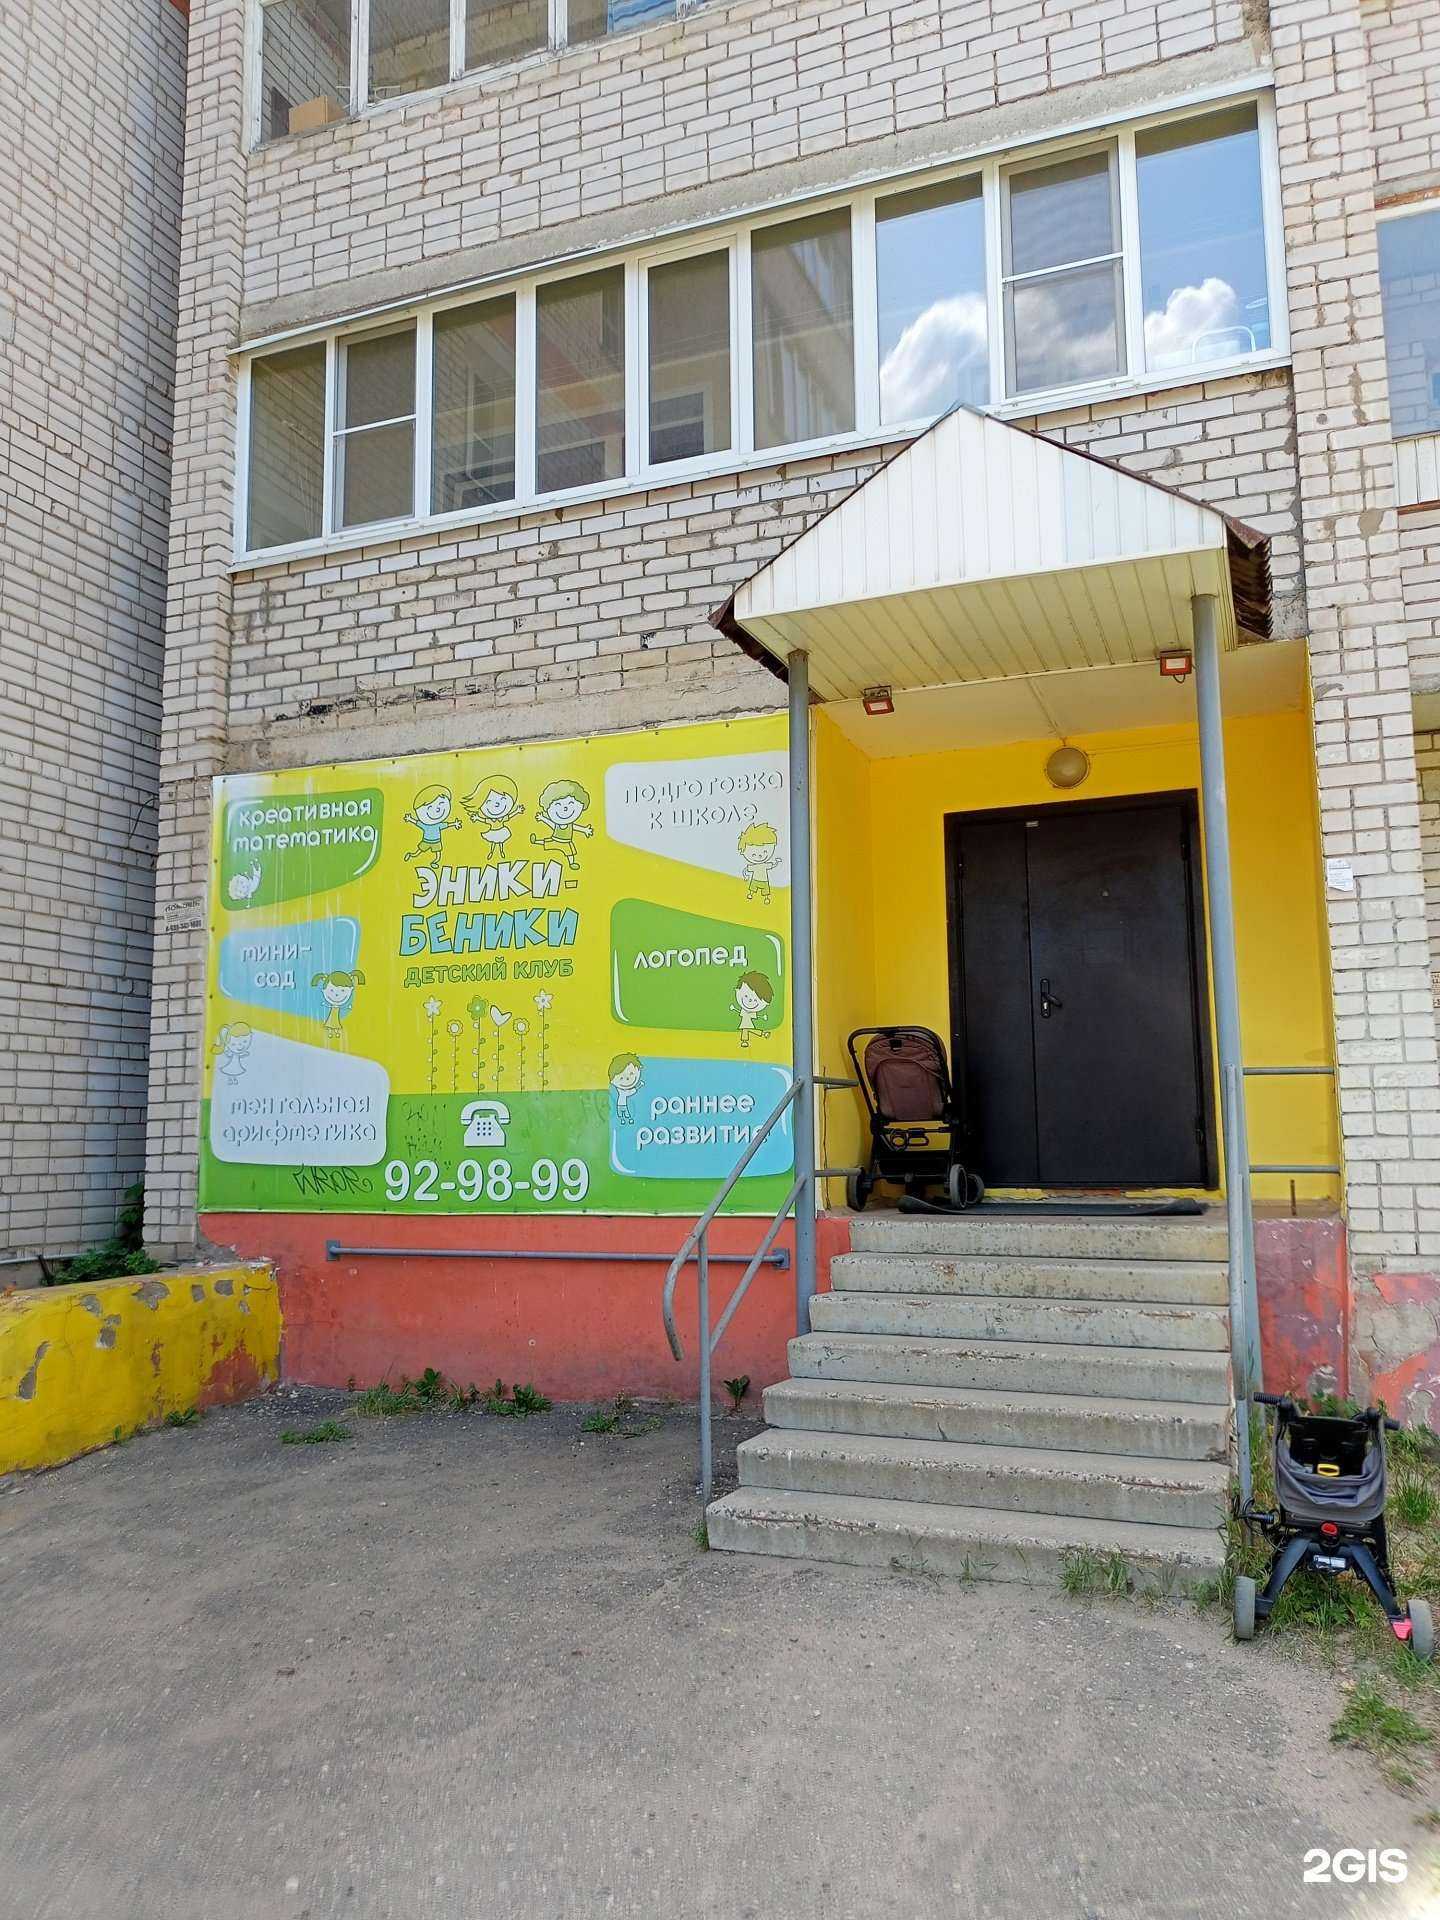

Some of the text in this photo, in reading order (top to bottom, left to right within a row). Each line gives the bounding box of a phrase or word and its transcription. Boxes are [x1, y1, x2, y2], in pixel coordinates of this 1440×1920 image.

[413, 859, 578, 908] ЭНИКИ-
[399, 907, 579, 956] БЕНИКИ
[404, 957, 573, 988] ДЕТСКИЙ КЛУБ
[651, 1094, 756, 1121] раннее
[384, 1158, 590, 1202] 92-98-99
